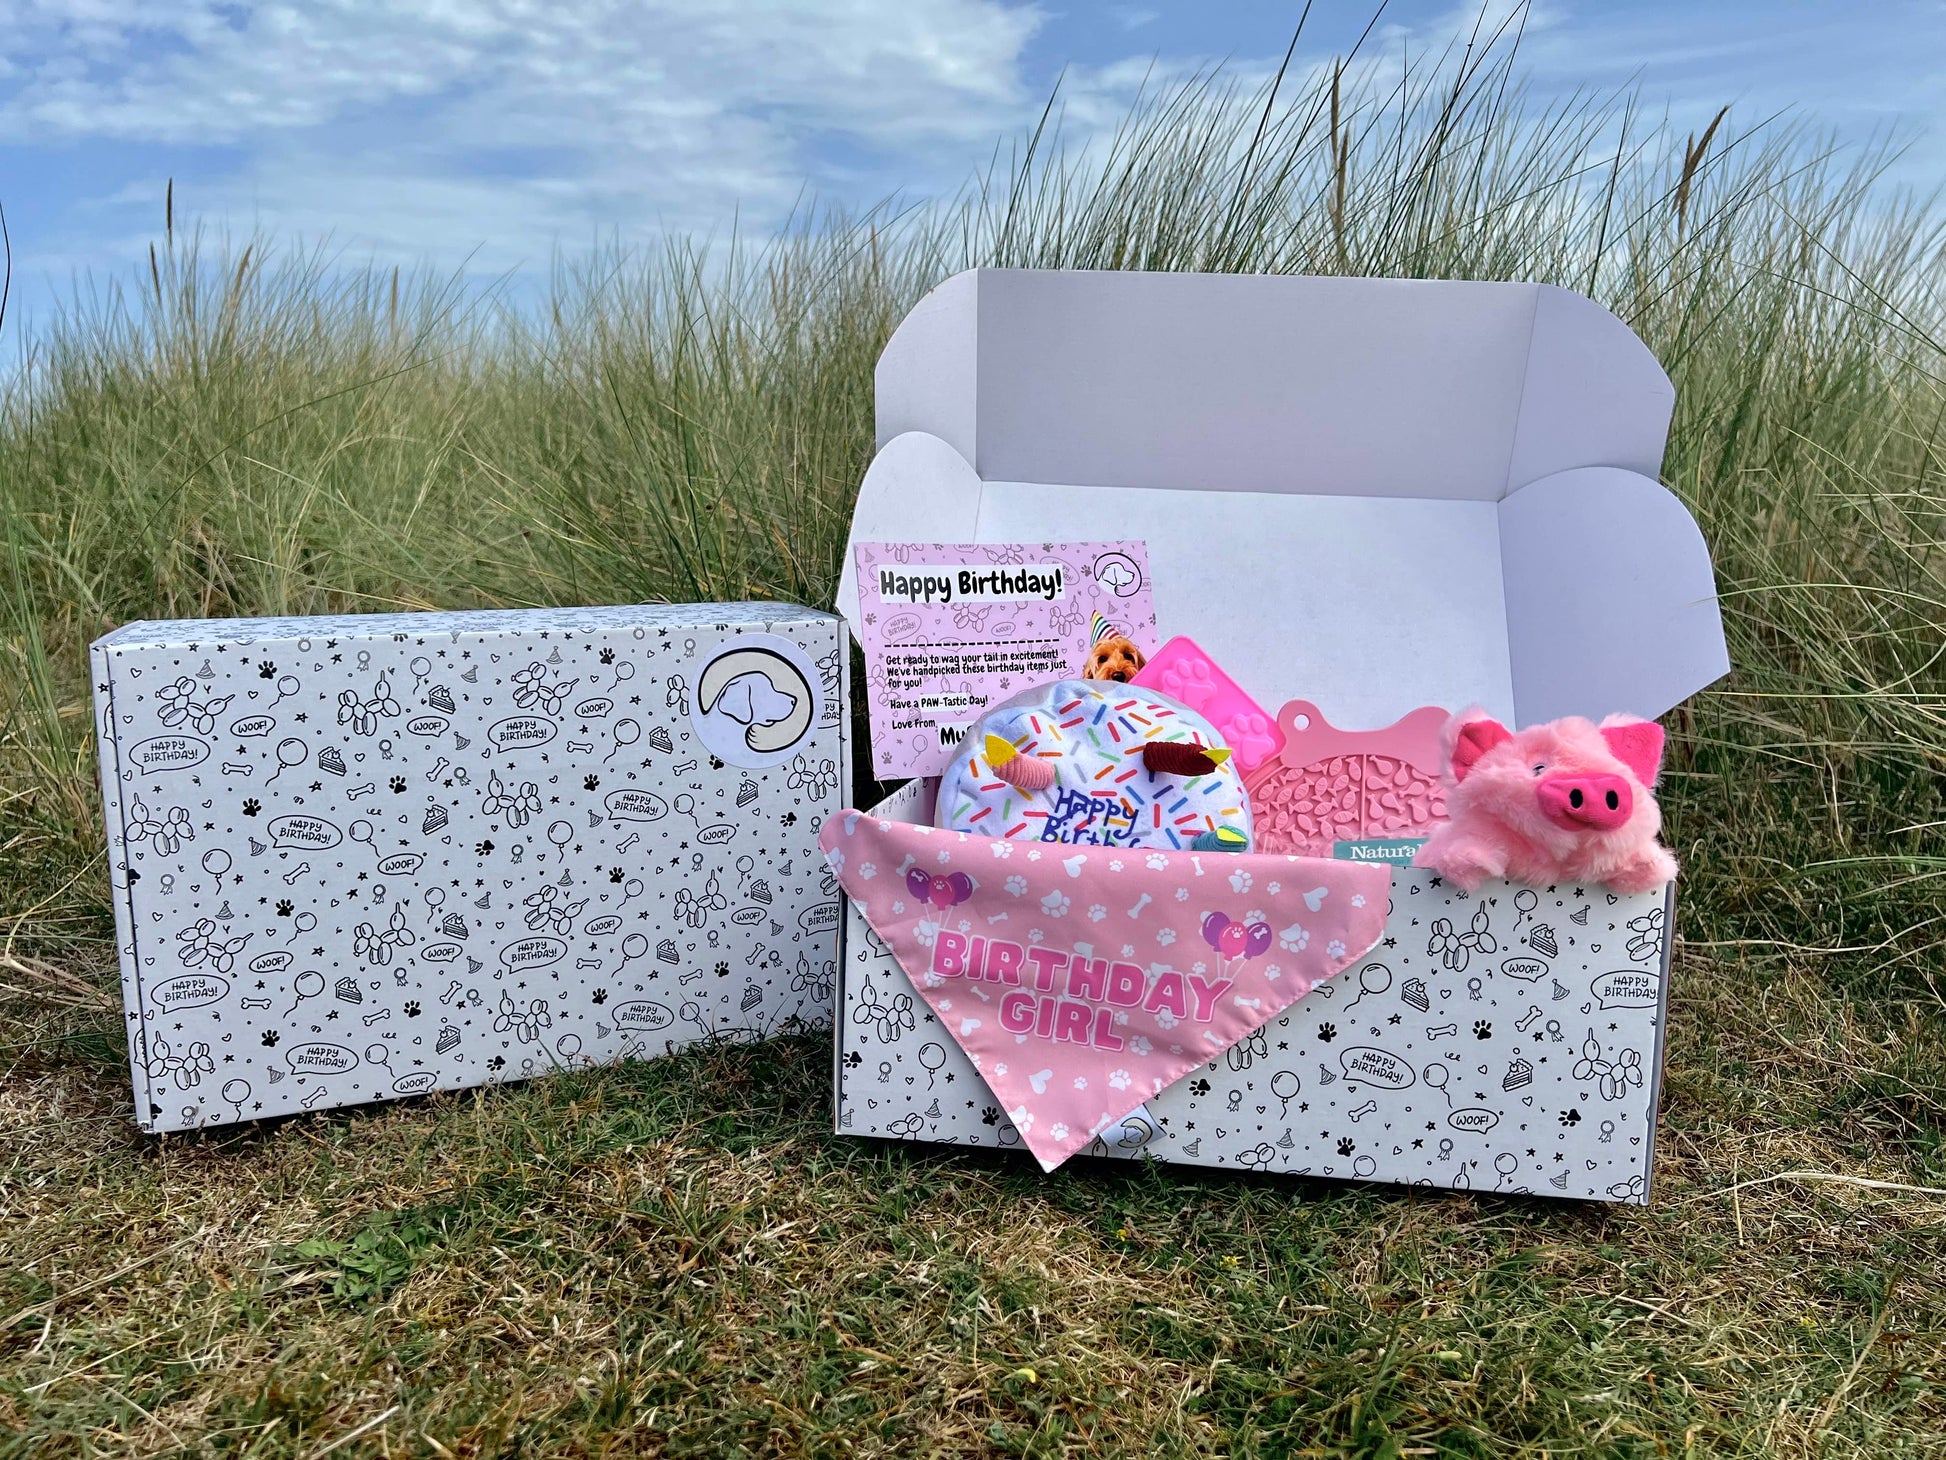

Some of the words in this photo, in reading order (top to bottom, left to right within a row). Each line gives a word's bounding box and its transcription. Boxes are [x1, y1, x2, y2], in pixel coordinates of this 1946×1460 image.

[880, 570, 951, 603] Happy
[958, 568, 1063, 600] Birthday!
[886, 655, 901, 665] Get
[903, 654, 928, 667] ready
[930, 654, 940, 664] to
[941, 655, 959, 666] wag
[961, 655, 981, 665] your
[984, 652, 998, 662] tail
[1000, 652, 1008, 661] in
[1010, 649, 1058, 660] excitement!
[887, 667, 911, 677] We've
[913, 664, 960, 678] handpicked
[962, 663, 985, 674] these
[987, 662, 1024, 674] birthday
[1027, 661, 1049, 671] items
[1050, 660, 1067, 672] just
[888, 678, 901, 688] for
[904, 677, 922, 691] you!
[890, 699, 912, 709] Have
[921, 696, 967, 708] PAW-Tastic
[969, 695, 988, 707] Day!
[581, 703, 606, 714] WOOF!
[237, 720, 267, 733] WOOF!
[414, 720, 441, 731] WOOF!
[506, 721, 536, 731] HAPPY
[892, 720, 912, 730] Love
[915, 719, 935, 728] From
[499, 729, 547, 741] BIRTHDAY!
[940, 725, 972, 746] Mu
[151, 741, 185, 751] HAPPY
[143, 748, 198, 763] BIRTHDAY!
[623, 793, 651, 805] HAPPY
[614, 802, 658, 816] BIRTHDAY!
[1054, 786, 1139, 839] Happy
[289, 820, 322, 832] HAPPY
[1040, 815, 1140, 848] Birth
[279, 828, 331, 844] BIRTHDAY!
[704, 829, 729, 840] WOOF!
[1350, 844, 1422, 859] Natura
[385, 859, 415, 871] WOOF!
[737, 911, 760, 922] WOOF!
[814, 906, 839, 916] HAPPY
[590, 919, 615, 931] WOOF!
[808, 915, 839, 926] BIRTHDA
[428, 947, 455, 958] WOOF!
[518, 941, 547, 952] HAPPY
[511, 949, 557, 962] BIRTHDAY!
[256, 957, 285, 969] WOOF!
[1508, 963, 1540, 975] WOOF!
[932, 929, 1233, 1023] BIRTHDAY
[1613, 976, 1649, 987] HAPPY
[172, 979, 205, 990] HAPPY
[164, 987, 218, 1001] BIRTHDAY!
[630, 1005, 658, 1015] HAPPY
[621, 1012, 665, 1025] BIRTHDAY!
[999, 991, 1125, 1051] GIRL
[307, 1047, 339, 1058] HAPPY
[297, 1054, 348, 1069] BIRTHDAY!
[1361, 1052, 1396, 1069] HAPPY
[1350, 1060, 1404, 1084] BIRTHDAY!
[399, 1077, 428, 1089] WOOF!
[1456, 1115, 1489, 1127] WOOF!
